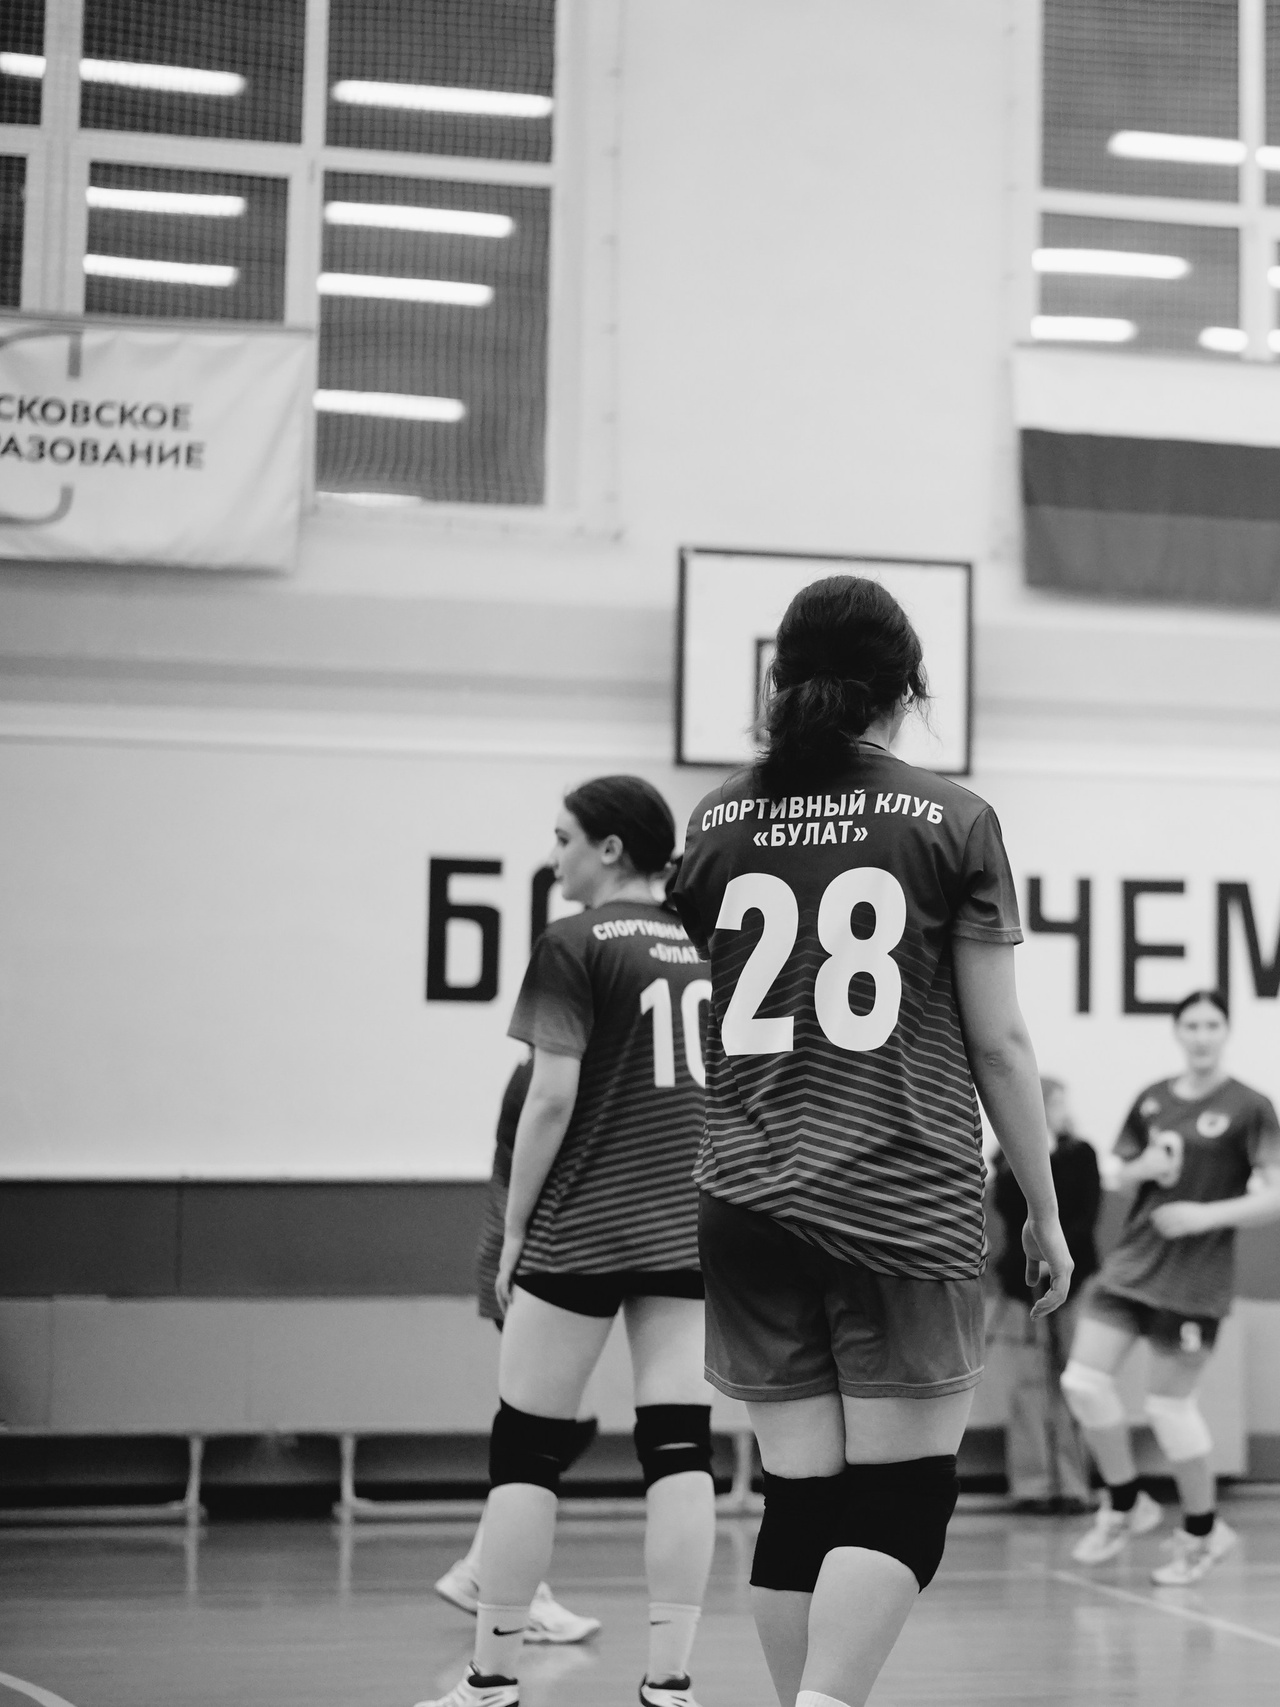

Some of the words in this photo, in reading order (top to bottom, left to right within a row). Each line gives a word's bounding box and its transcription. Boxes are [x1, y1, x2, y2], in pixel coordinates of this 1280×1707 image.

[0, 433, 206, 470] АЗОВАНИЕ
[701, 789, 866, 831] СПОРТИВНЫЙ
[874, 793, 944, 824] КЛУБ
[753, 821, 868, 847] «БУЛАТ»
[715, 867, 906, 1056] 28
